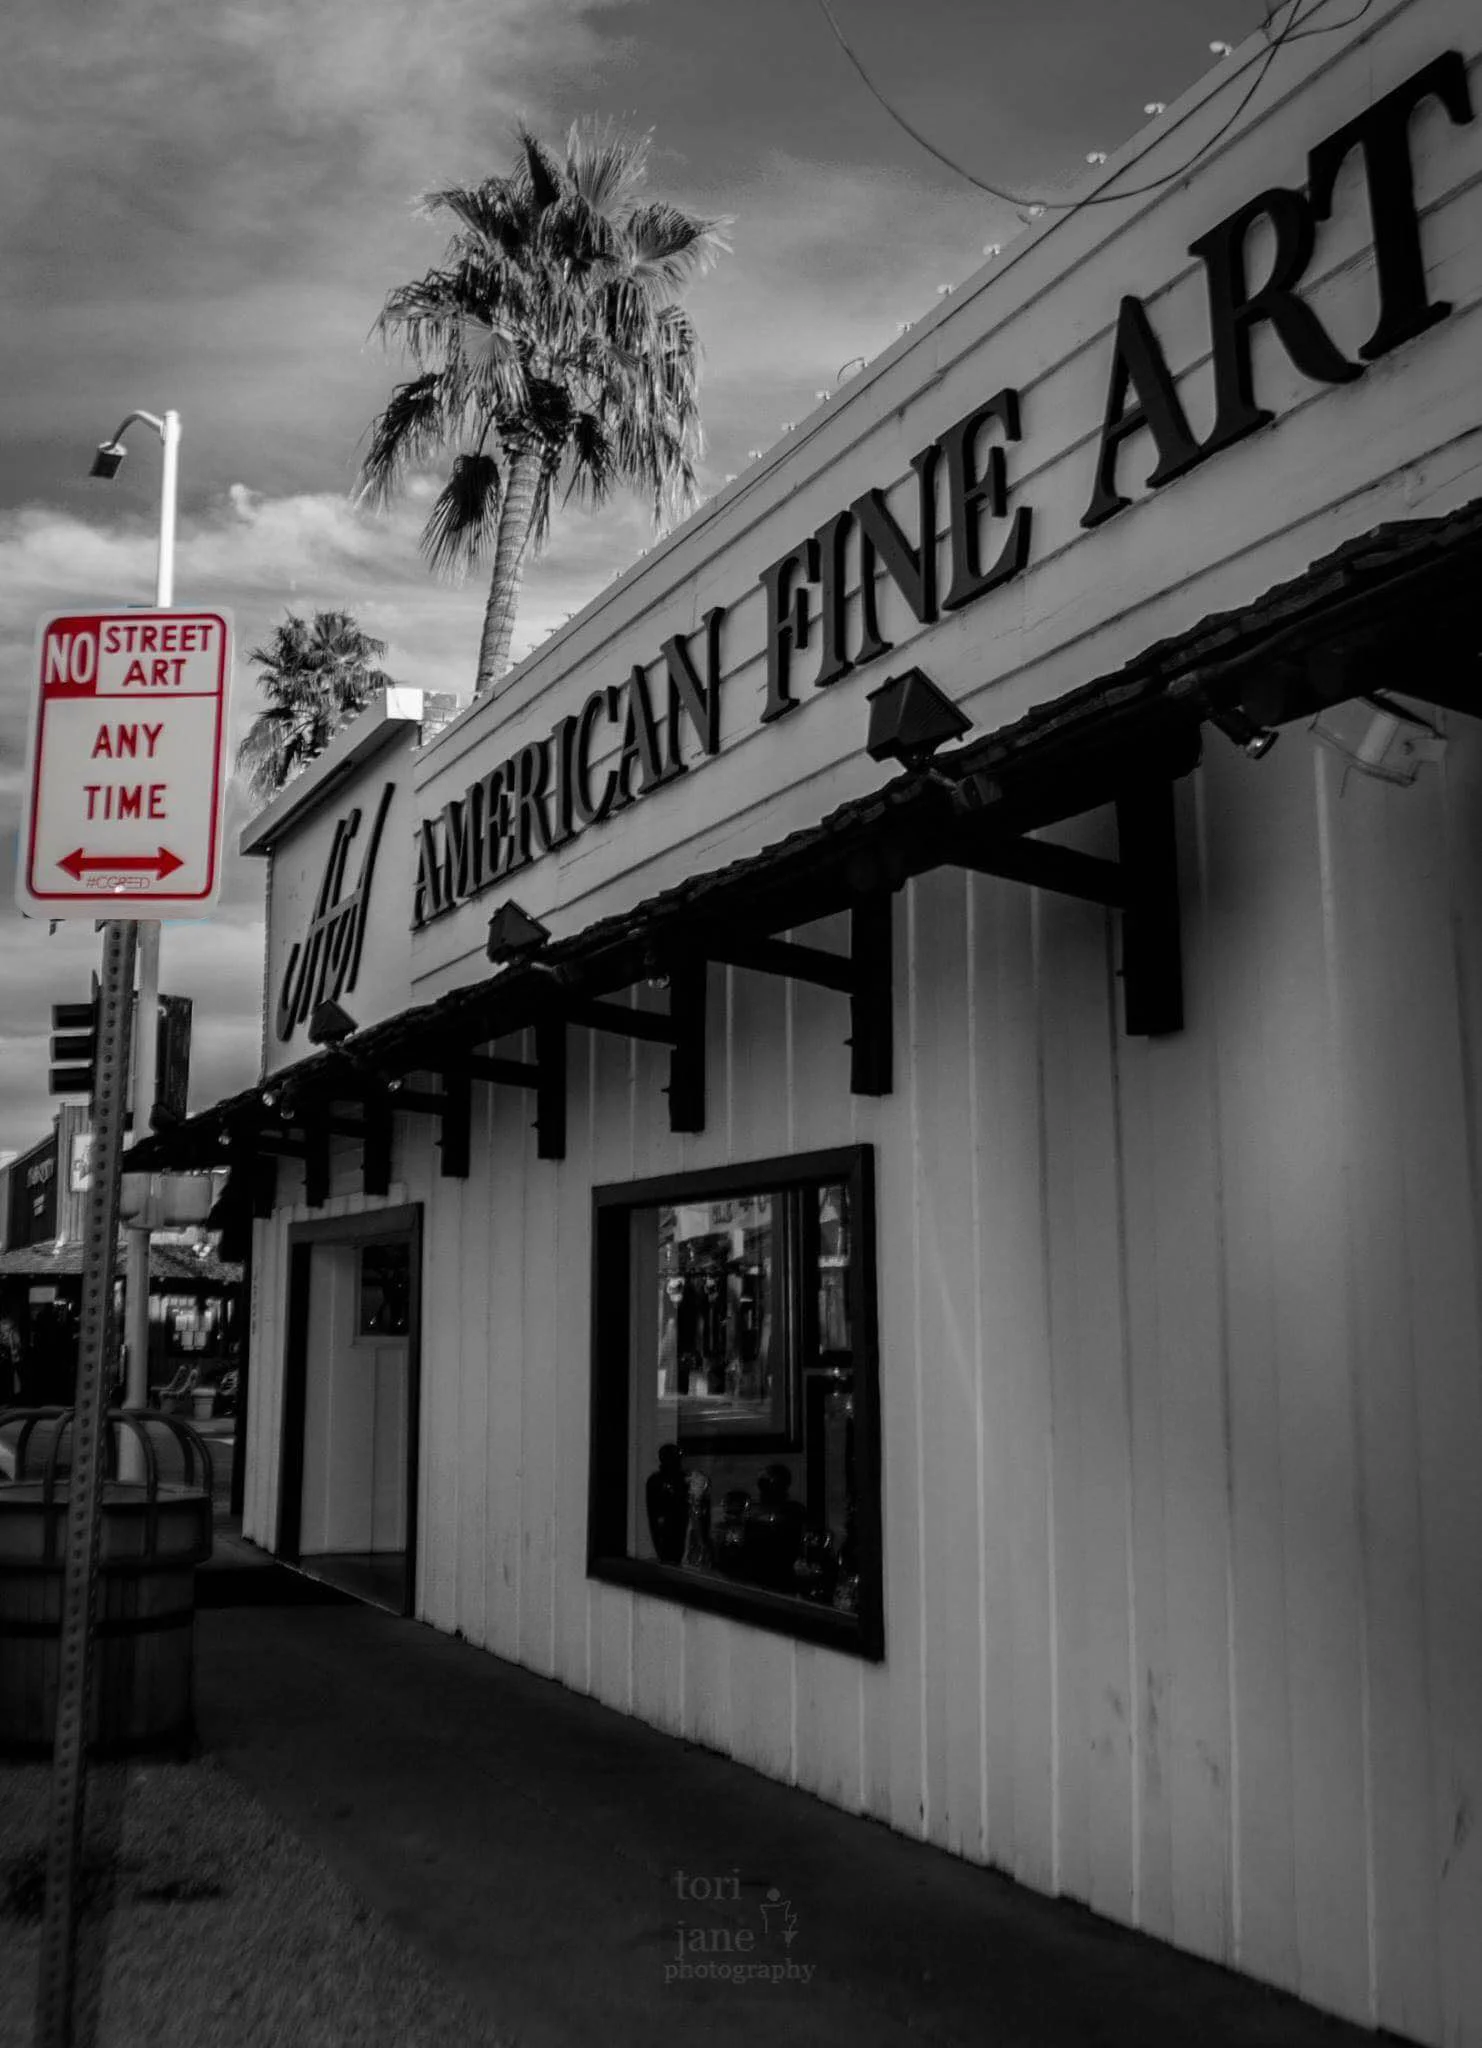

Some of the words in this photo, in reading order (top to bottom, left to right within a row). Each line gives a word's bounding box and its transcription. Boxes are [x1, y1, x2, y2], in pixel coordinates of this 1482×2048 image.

[410, 606, 725, 931] AMERICAN
[759, 387, 1033, 724] FINE
[1080, 49, 1475, 529] ART
[45, 630, 97, 686] NO
[104, 624, 214, 655] STREET
[122, 657, 187, 687] ART
[90, 723, 164, 759] ANY
[83, 783, 168, 821] TIME
